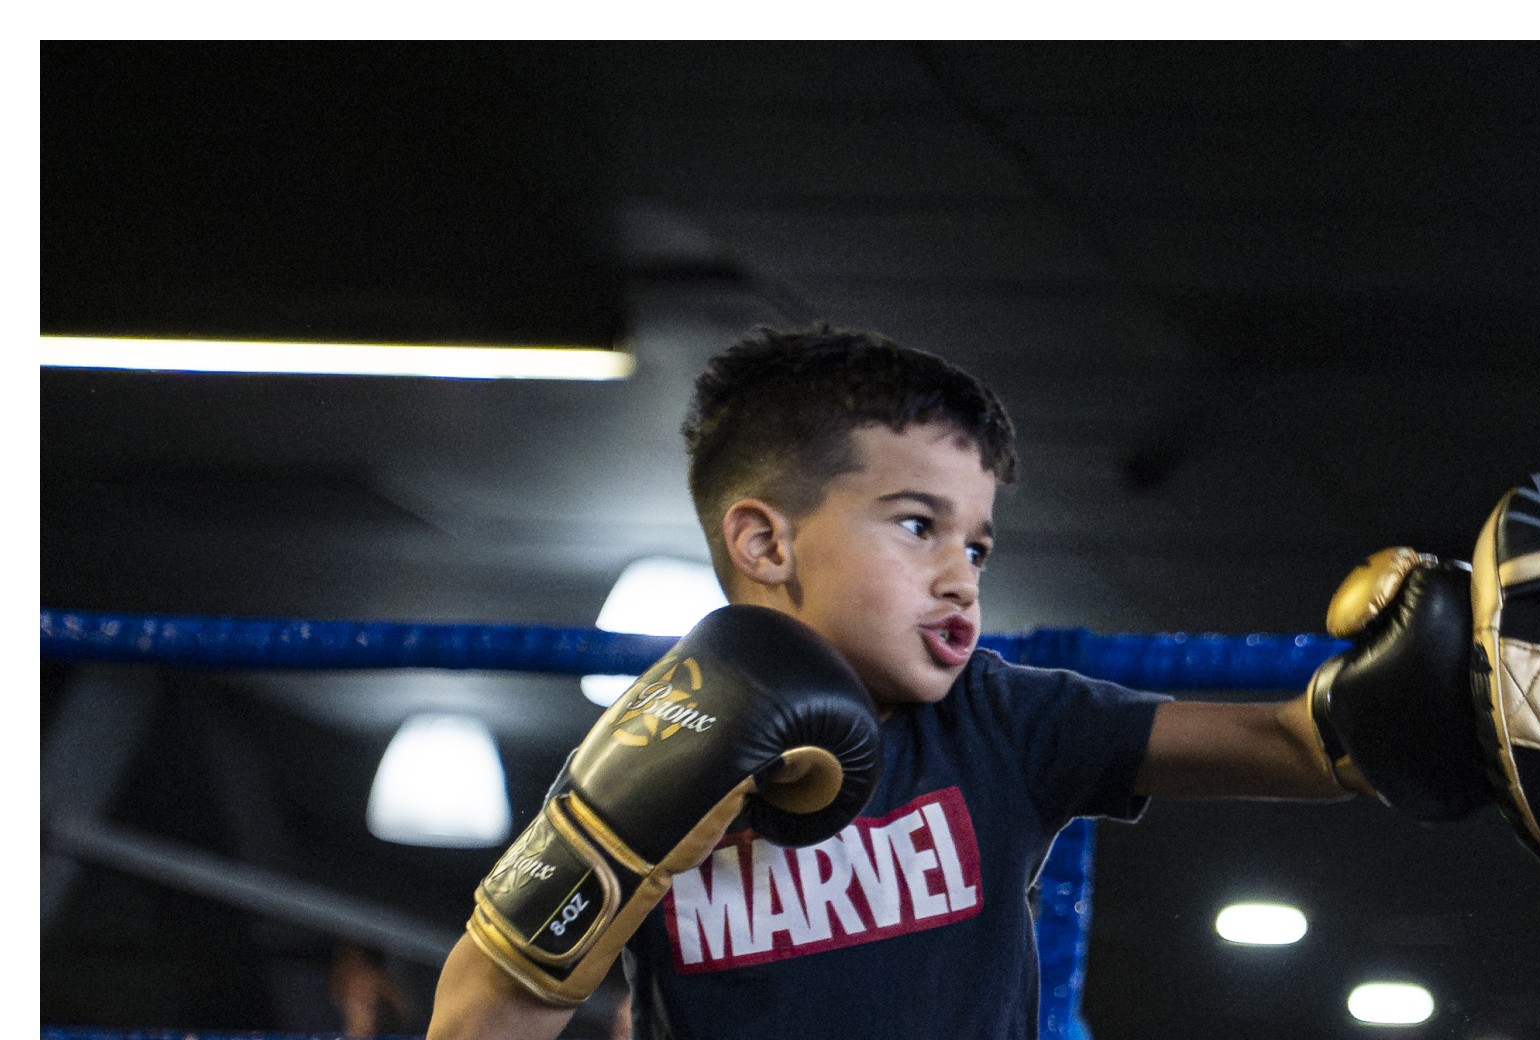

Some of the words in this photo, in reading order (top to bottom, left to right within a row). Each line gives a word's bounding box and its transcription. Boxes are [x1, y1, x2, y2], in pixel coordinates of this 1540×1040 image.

[627, 681, 717, 734] Bronx
[671, 801, 977, 965] MARVEL
[549, 891, 591, 937] 8-OZ
